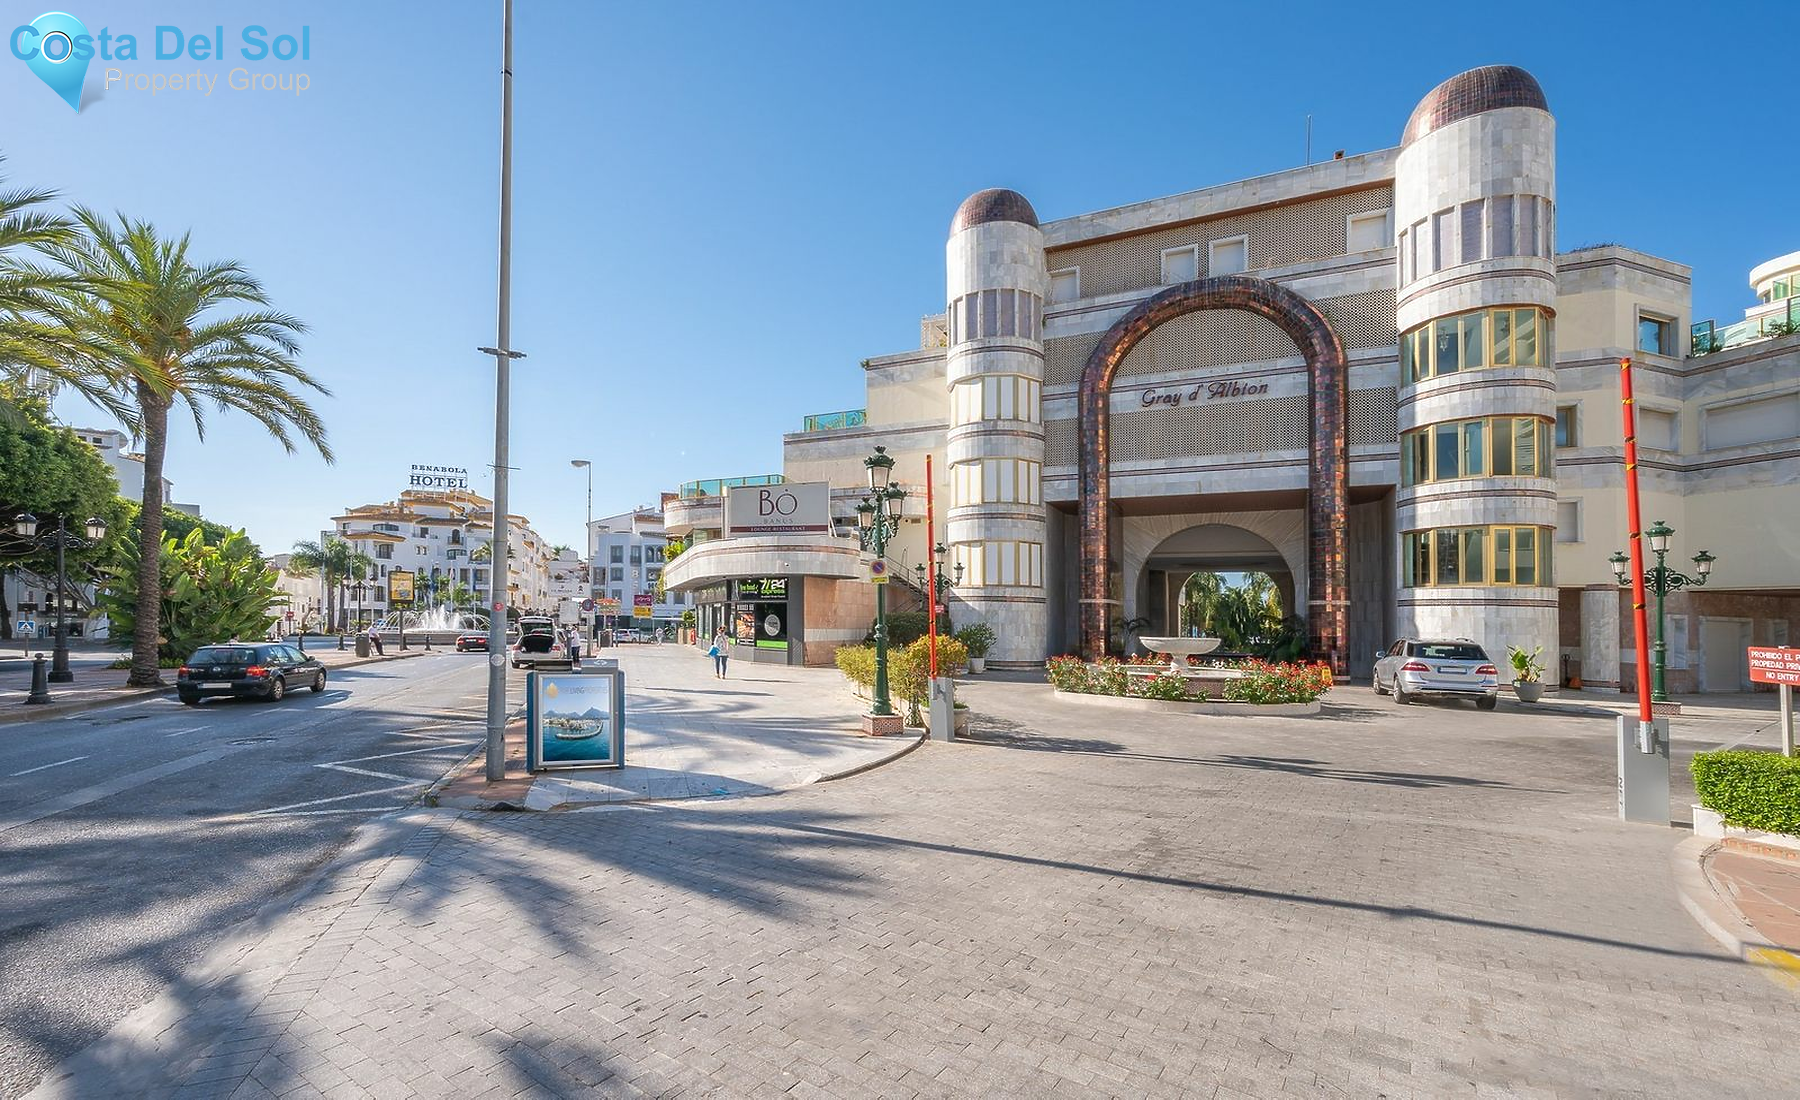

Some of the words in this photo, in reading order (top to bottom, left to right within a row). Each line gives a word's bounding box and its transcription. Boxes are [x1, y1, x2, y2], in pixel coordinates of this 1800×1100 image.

[1142, 389, 1183, 407] Gray
[1207, 381, 1269, 399] Albion
[411, 464, 468, 474] BENABOLA
[409, 475, 468, 488] HOTEL
[1751, 651, 1782, 659] PROHIBIDO
[1784, 653, 1793, 661] EL
[1751, 660, 1784, 668] PROPIEDAD
[1766, 671, 1775, 679] NO
[1777, 672, 1799, 681] ENTRY
